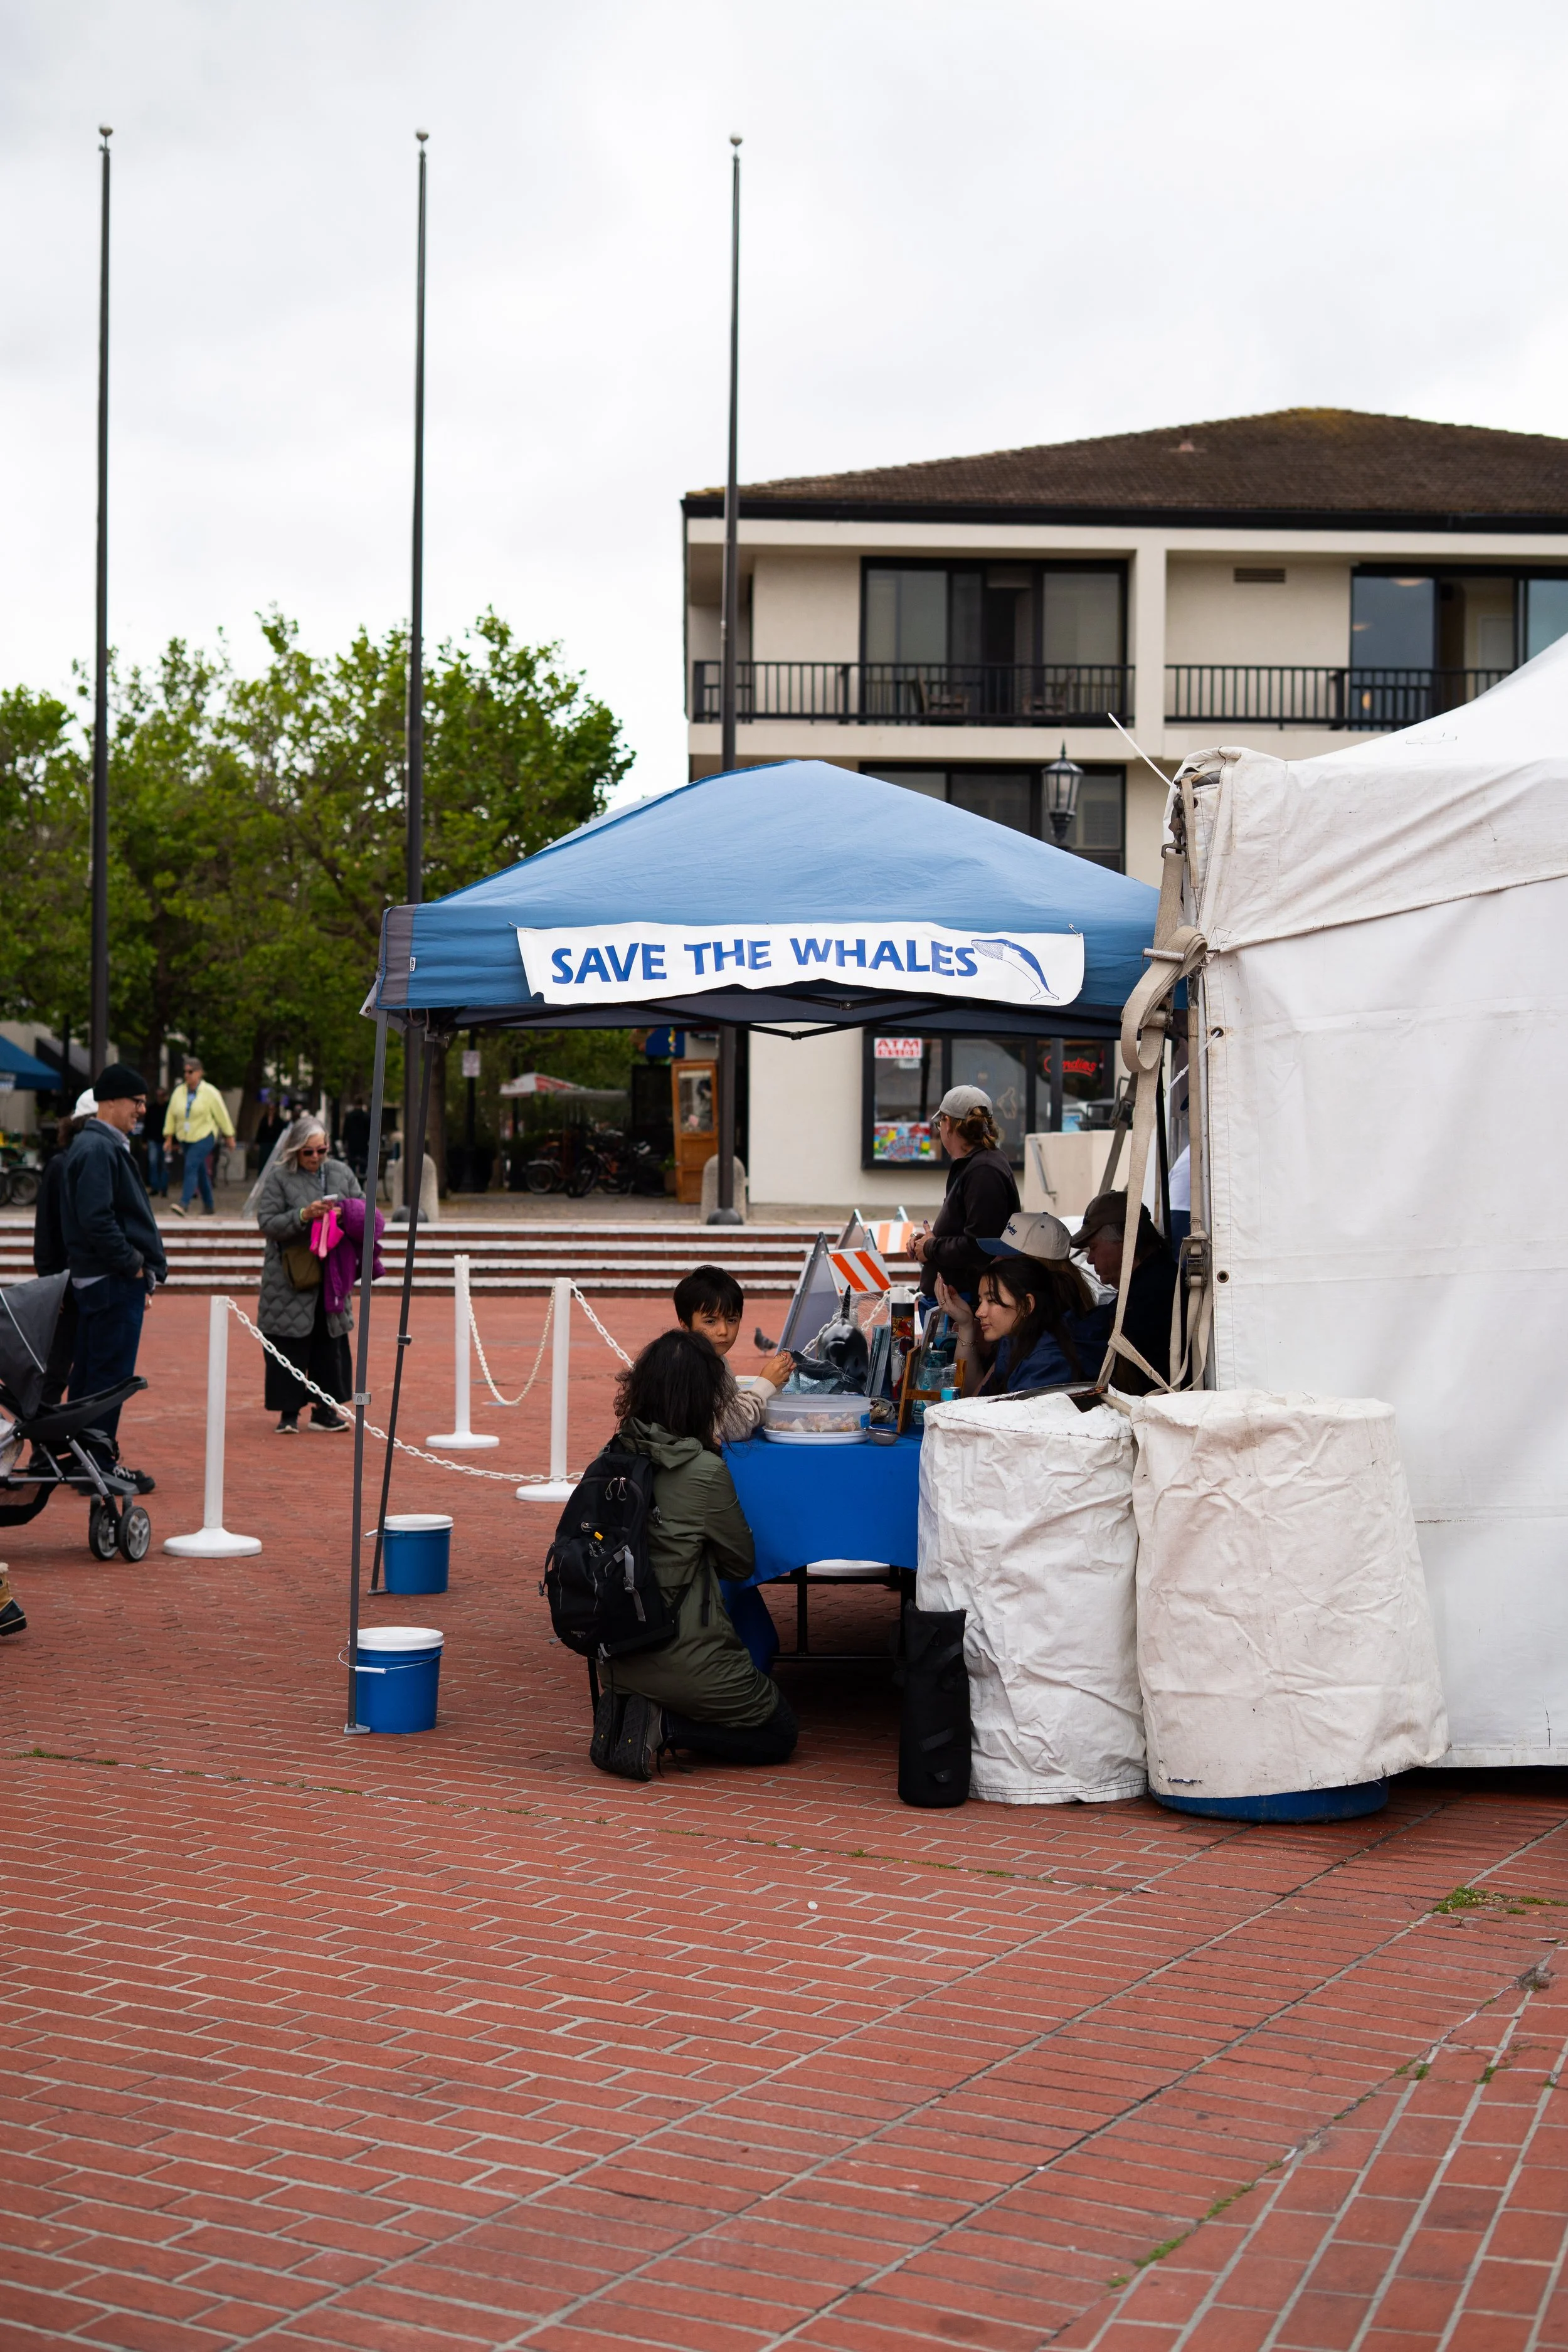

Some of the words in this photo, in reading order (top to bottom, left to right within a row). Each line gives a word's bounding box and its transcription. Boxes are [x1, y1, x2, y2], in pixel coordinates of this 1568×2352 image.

[551, 942, 667, 985] SAVE
[684, 938, 771, 975] THE
[789, 938, 978, 977] WHALES
[878, 1038, 919, 1048] ATM
[1044, 1055, 1097, 1073] Cndies
